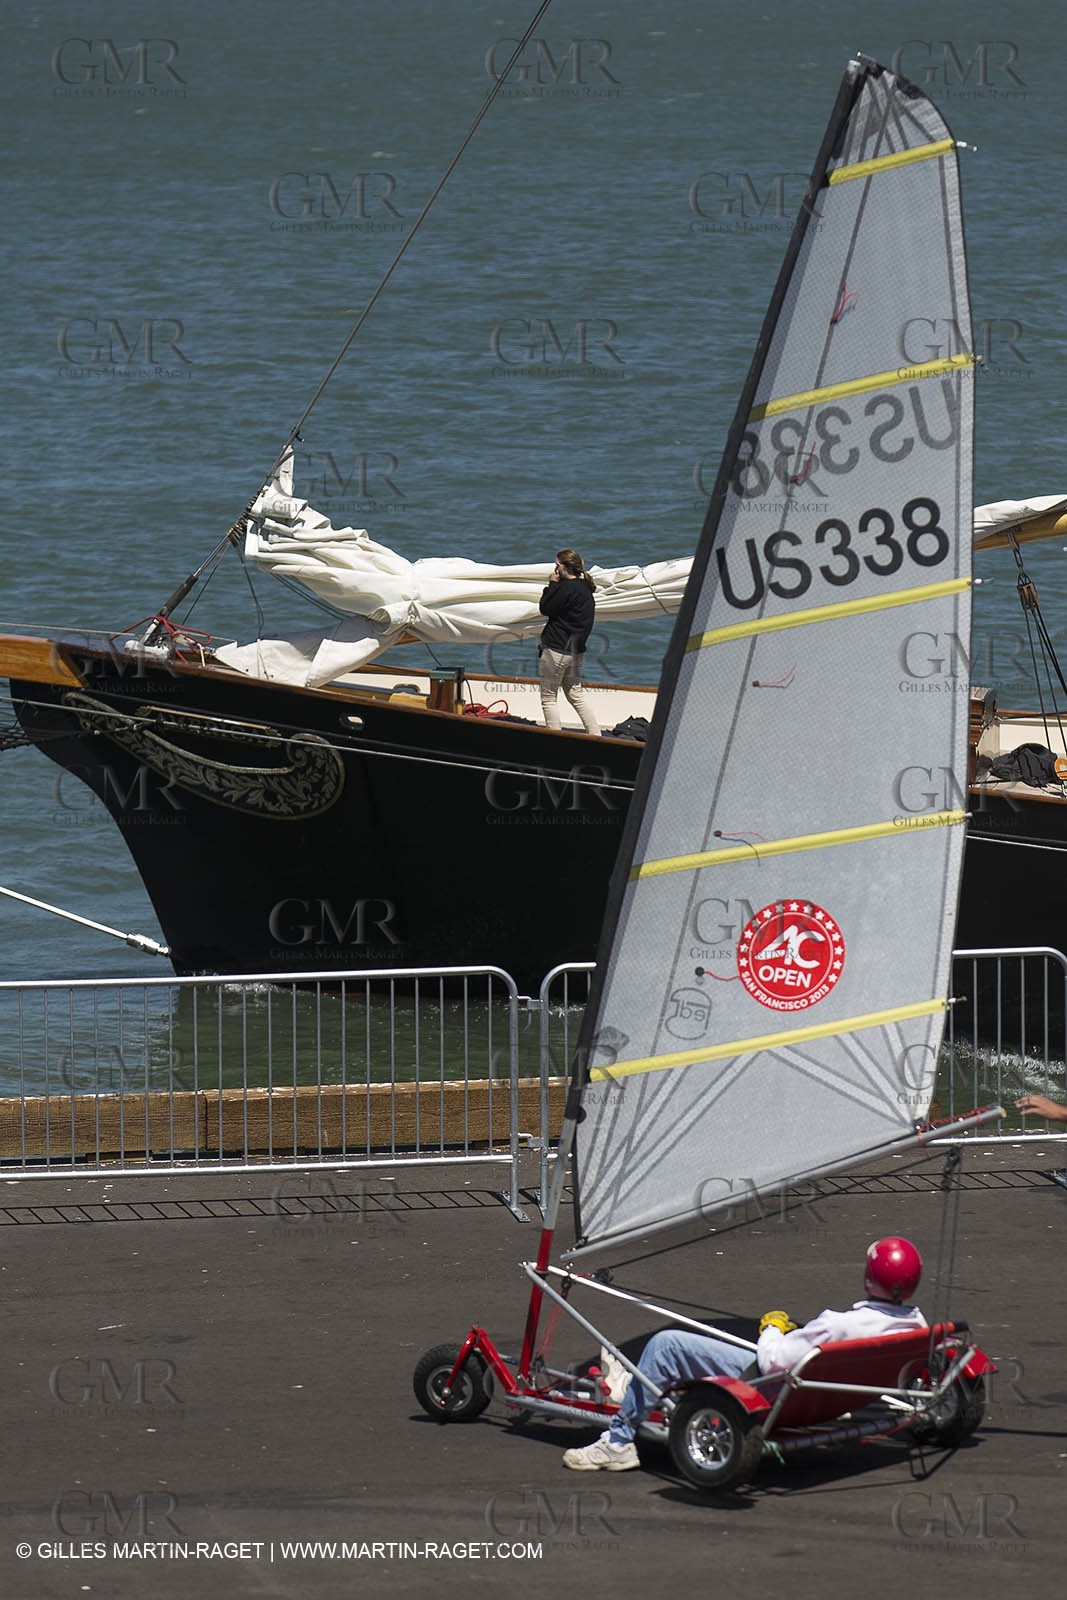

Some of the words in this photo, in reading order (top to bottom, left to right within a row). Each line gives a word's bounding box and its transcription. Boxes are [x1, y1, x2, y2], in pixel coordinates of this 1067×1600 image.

[715, 497, 950, 609] US338
[741, 971, 756, 992] SAN
[754, 989, 808, 1010] FRANCISCO
[808, 985, 830, 1004] 2013
[758, 965, 812, 988] OPEN
